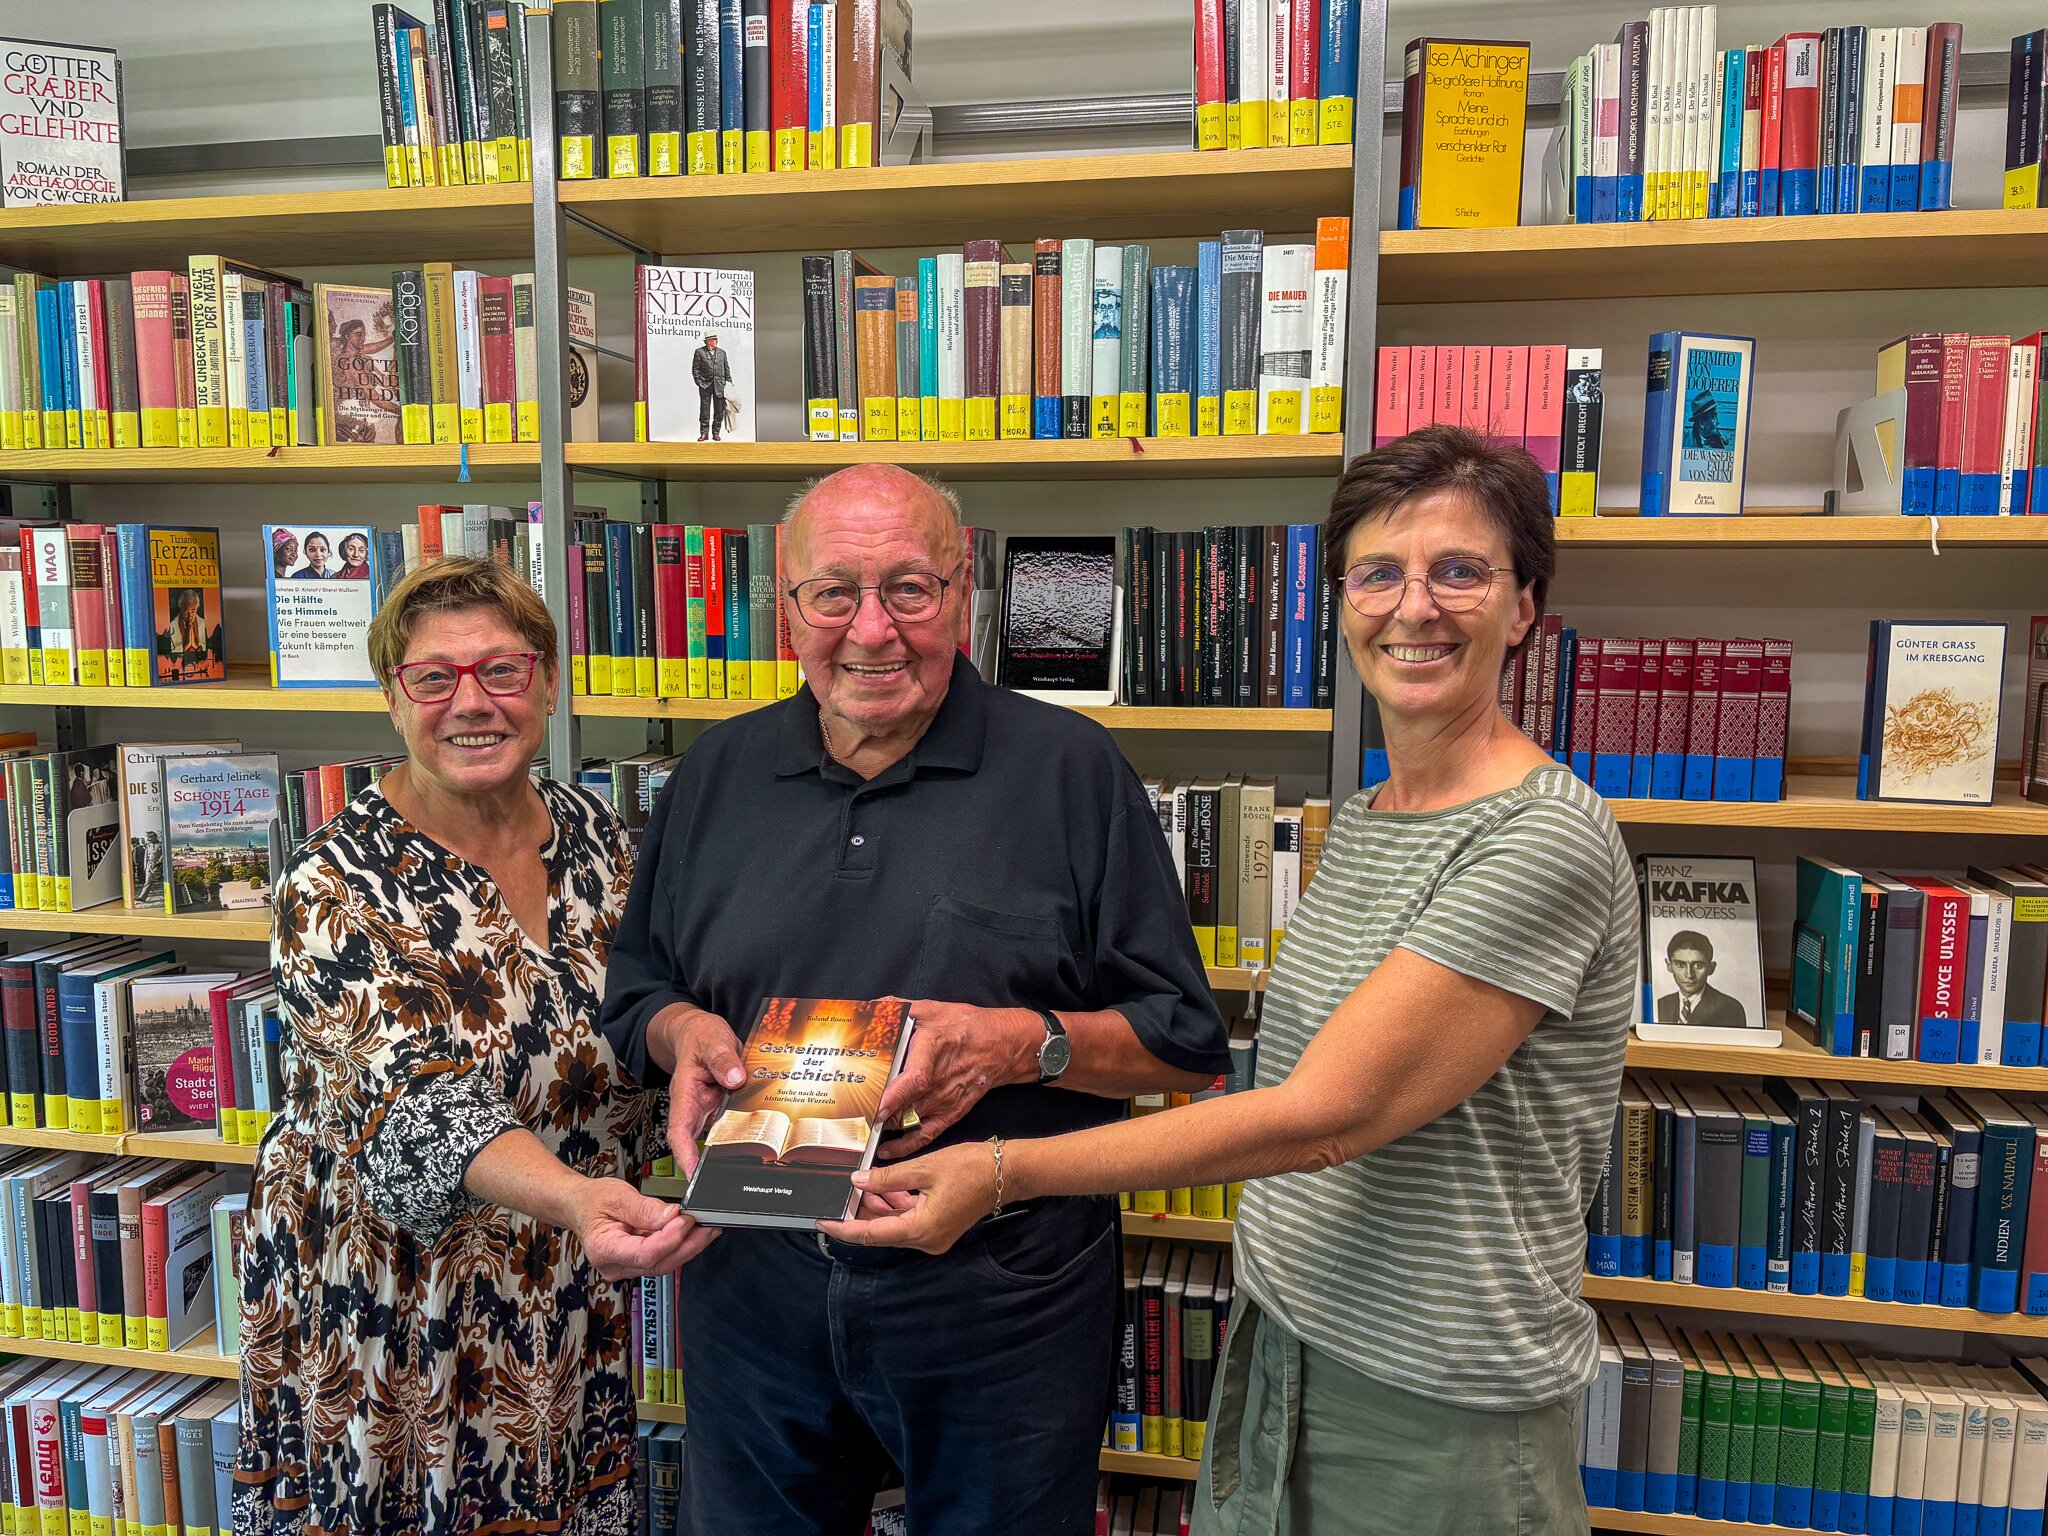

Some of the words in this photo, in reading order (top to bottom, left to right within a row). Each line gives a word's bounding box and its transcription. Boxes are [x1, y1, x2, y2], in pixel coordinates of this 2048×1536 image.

[825, 9, 833, 52] Bürgerkrieg
[1275, 13, 1285, 74] MITLEIDSINDUSTRIE
[1303, 39, 1311, 65] Feyder
[1631, 34, 1640, 66] MALINA
[1451, 46, 1525, 75] Aichinger
[825, 56, 833, 91] Spanische
[1275, 76, 1284, 86] DIE
[1426, 72, 1442, 85] Die
[1443, 74, 1480, 89] größere
[1482, 75, 1523, 92] Hoffnung
[1464, 89, 1484, 97] Roman
[1630, 70, 1639, 116] BACHMANN
[31, 97, 83, 118] VND
[1458, 101, 1488, 114] Meine
[0, 115, 119, 144] GELEHRTE
[1436, 111, 1475, 128] Sprache
[1477, 114, 1495, 125] und
[1496, 114, 1508, 126] ich
[1454, 127, 1489, 138] Erzählungen
[1629, 118, 1638, 160] INGEBORG
[1436, 140, 1491, 153] verschenkter
[1493, 140, 1506, 153] Rat
[17, 162, 71, 176] ROMAN
[73, 164, 107, 179] DER
[2, 185, 37, 200] VON
[192, 268, 203, 301] WELT
[202, 268, 216, 302] MAYA
[647, 269, 721, 295] PAUL
[716, 269, 752, 281] Journal
[731, 280, 753, 289] 2000
[731, 288, 753, 296] 2010
[1269, 291, 1280, 301] DIE
[1282, 291, 1307, 301] MAUER
[400, 281, 421, 346] Kongo
[647, 293, 751, 319] NIZON
[76, 304, 87, 335] Israel
[205, 306, 217, 329] DER
[647, 314, 753, 330] Urkundenfälschung
[434, 308, 445, 354] griechischen
[647, 325, 701, 338] Suhrkamp
[194, 303, 207, 382] UNBEKANNTE
[1543, 354, 1551, 370] Werke
[1689, 350, 1735, 367] HEIMITO
[1688, 364, 1710, 377] VON
[197, 386, 208, 405] DIE
[1688, 377, 1739, 392] DODERER
[1577, 404, 1587, 433] BRECHT
[1576, 435, 1586, 468] BERTOLT
[1684, 449, 1698, 461] DIE
[153, 536, 216, 560] Terzani
[170, 535, 197, 545] Tiziano
[44, 543, 58, 582] MAO
[152, 560, 170, 576] In
[173, 558, 217, 577] Asien
[1248, 566, 1256, 603] Revolution
[1271, 579, 1279, 602] wäre,
[9, 580, 18, 614] Schwäne
[1270, 603, 1278, 620] Was
[11, 615, 19, 637] Wilde
[295, 619, 325, 627] Frauen
[279, 642, 311, 650] Zukunft
[315, 642, 354, 651] kämpfen
[1896, 639, 1939, 650] GÜNTER
[1942, 640, 1976, 651] GRASS
[1905, 653, 1920, 663] IM
[1922, 653, 1985, 665] KREBSGANG
[180, 772, 225, 784] Gerhard
[227, 771, 262, 783] Jelinek
[34, 778, 45, 827] DIKTATOREN
[199, 800, 246, 817] 1914
[1200, 794, 1212, 829] BÖSE
[1244, 812, 1270, 820] BÖSCH
[37, 829, 47, 844] DER
[1290, 824, 1298, 852] PIPER
[1201, 840, 1211, 867] GUT
[1242, 835, 1250, 884] Zeitenwende
[1254, 840, 1269, 881] 1979
[1650, 864, 1692, 878] FRANZ
[1651, 881, 1751, 904] KAFKA
[1848, 884, 1856, 905] jandl
[1652, 905, 1677, 919] DER
[1679, 905, 1736, 920] PROZESS
[1940, 902, 1957, 959] ULYSSES
[1936, 965, 1952, 1007] JOYCE
[45, 987, 59, 1056] BLOODLANDS
[759, 1042, 877, 1057] Geheimnisse
[802, 1058, 825, 1066] der
[176, 1077, 206, 1089] Stadt
[753, 1067, 866, 1083] Geschichte
[764, 1095, 805, 1103] historischen
[1628, 1109, 1639, 1136] MEIN
[1628, 1140, 1638, 1168] HERZ
[2002, 1139, 2018, 1190] NAIPAUL
[1628, 1171, 1638, 1184] SO
[743, 1185, 773, 1194] Weishaupt
[774, 1187, 793, 1195] Verlag
[1627, 1186, 1638, 1220] WEISS
[1996, 1219, 2010, 1262] INDIEN
[1125, 1324, 1134, 1370] CRIME
[1126, 1376, 1136, 1411] MILLAR
[36, 1440, 53, 1496] Lenin
